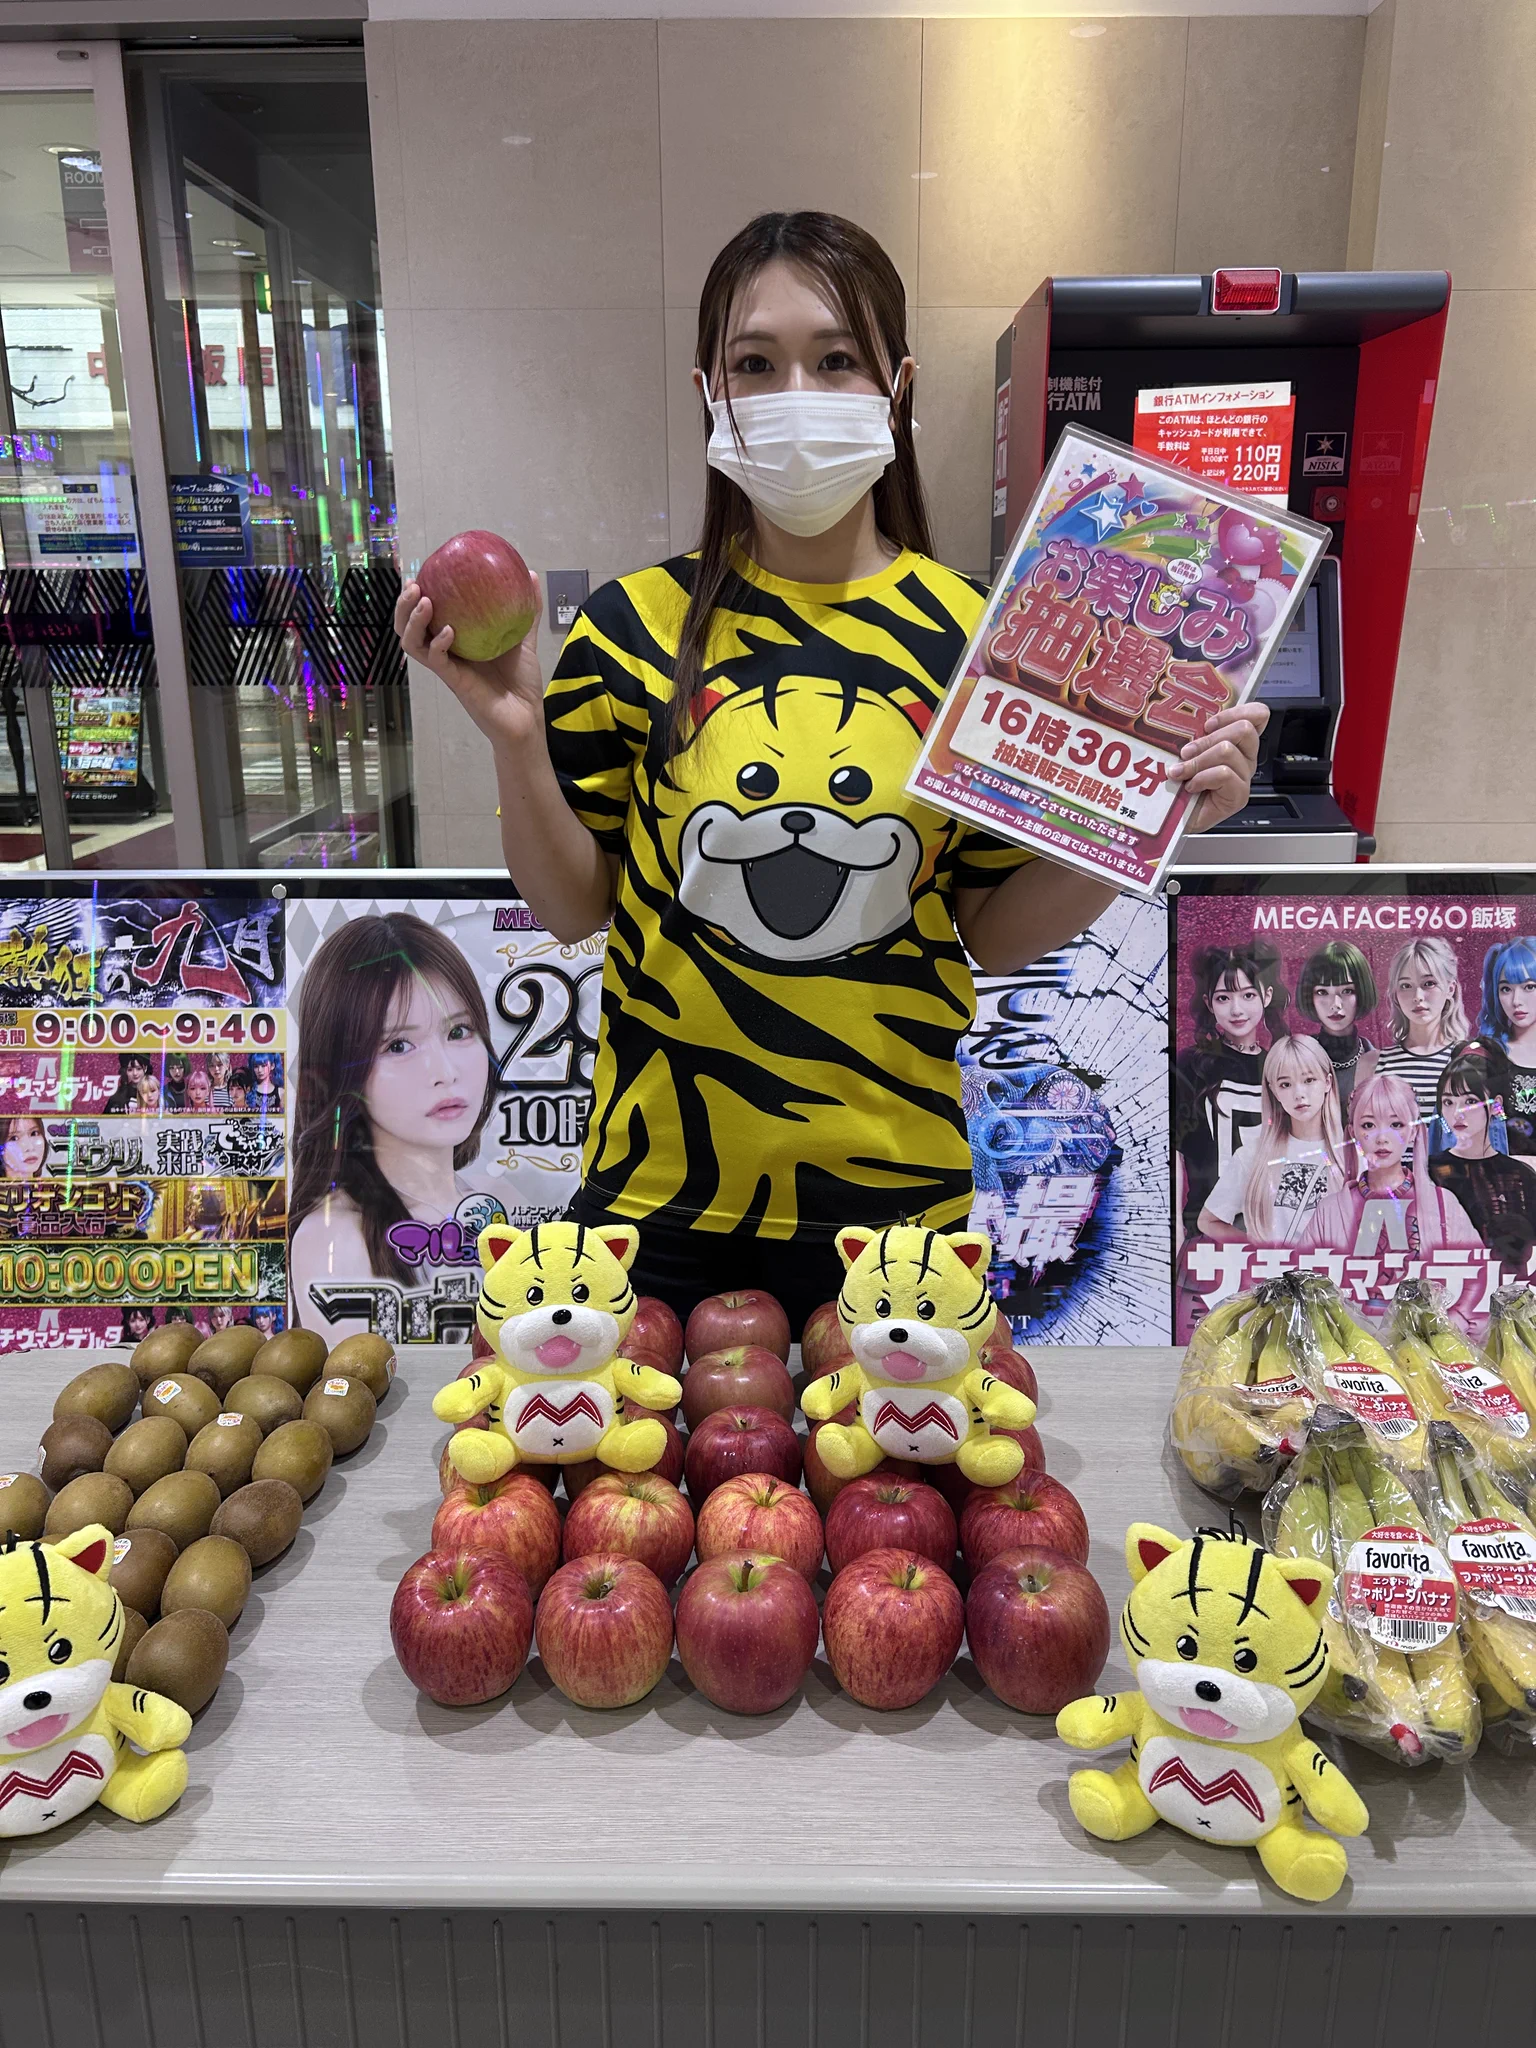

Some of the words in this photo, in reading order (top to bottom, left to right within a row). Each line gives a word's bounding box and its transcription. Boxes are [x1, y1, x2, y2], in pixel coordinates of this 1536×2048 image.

[1047, 392, 1101, 411] 行ATM
[1153, 389, 1275, 407] 銀行ATMインフォメーション
[1158, 414, 1268, 425] このATMは、ほとんどの銀行の
[1157, 427, 1268, 438] キャッシュカードが利用できて、
[1157, 441, 1191, 452] 手数料は
[1235, 445, 1282, 463] 110円
[1201, 469, 1226, 477] 上記以外
[1232, 464, 1280, 481] 220円
[1308, 461, 1340, 471] NISIK
[1033, 538, 1253, 660] お楽しみ
[992, 584, 1233, 742] 抽選会
[980, 689, 1170, 798] 16時30分
[991, 738, 1125, 813] 抽選販売開始
[1119, 805, 1138, 820] 予定
[923, 775, 1147, 879] お楽しみ抽選会はホール主催の企画ではございません
[1253, 906, 1339, 930] MEGA
[1470, 905, 1517, 929] 飯塚
[156, 1129, 203, 1152] 実践
[156, 1152, 203, 1176] 来店
[1187, 1243, 1536, 1313] サチウマンデル
[1333, 1374, 1386, 1394] favorita
[1461, 1539, 1527, 1560] favorita
[1365, 1547, 1431, 1573] favorita
